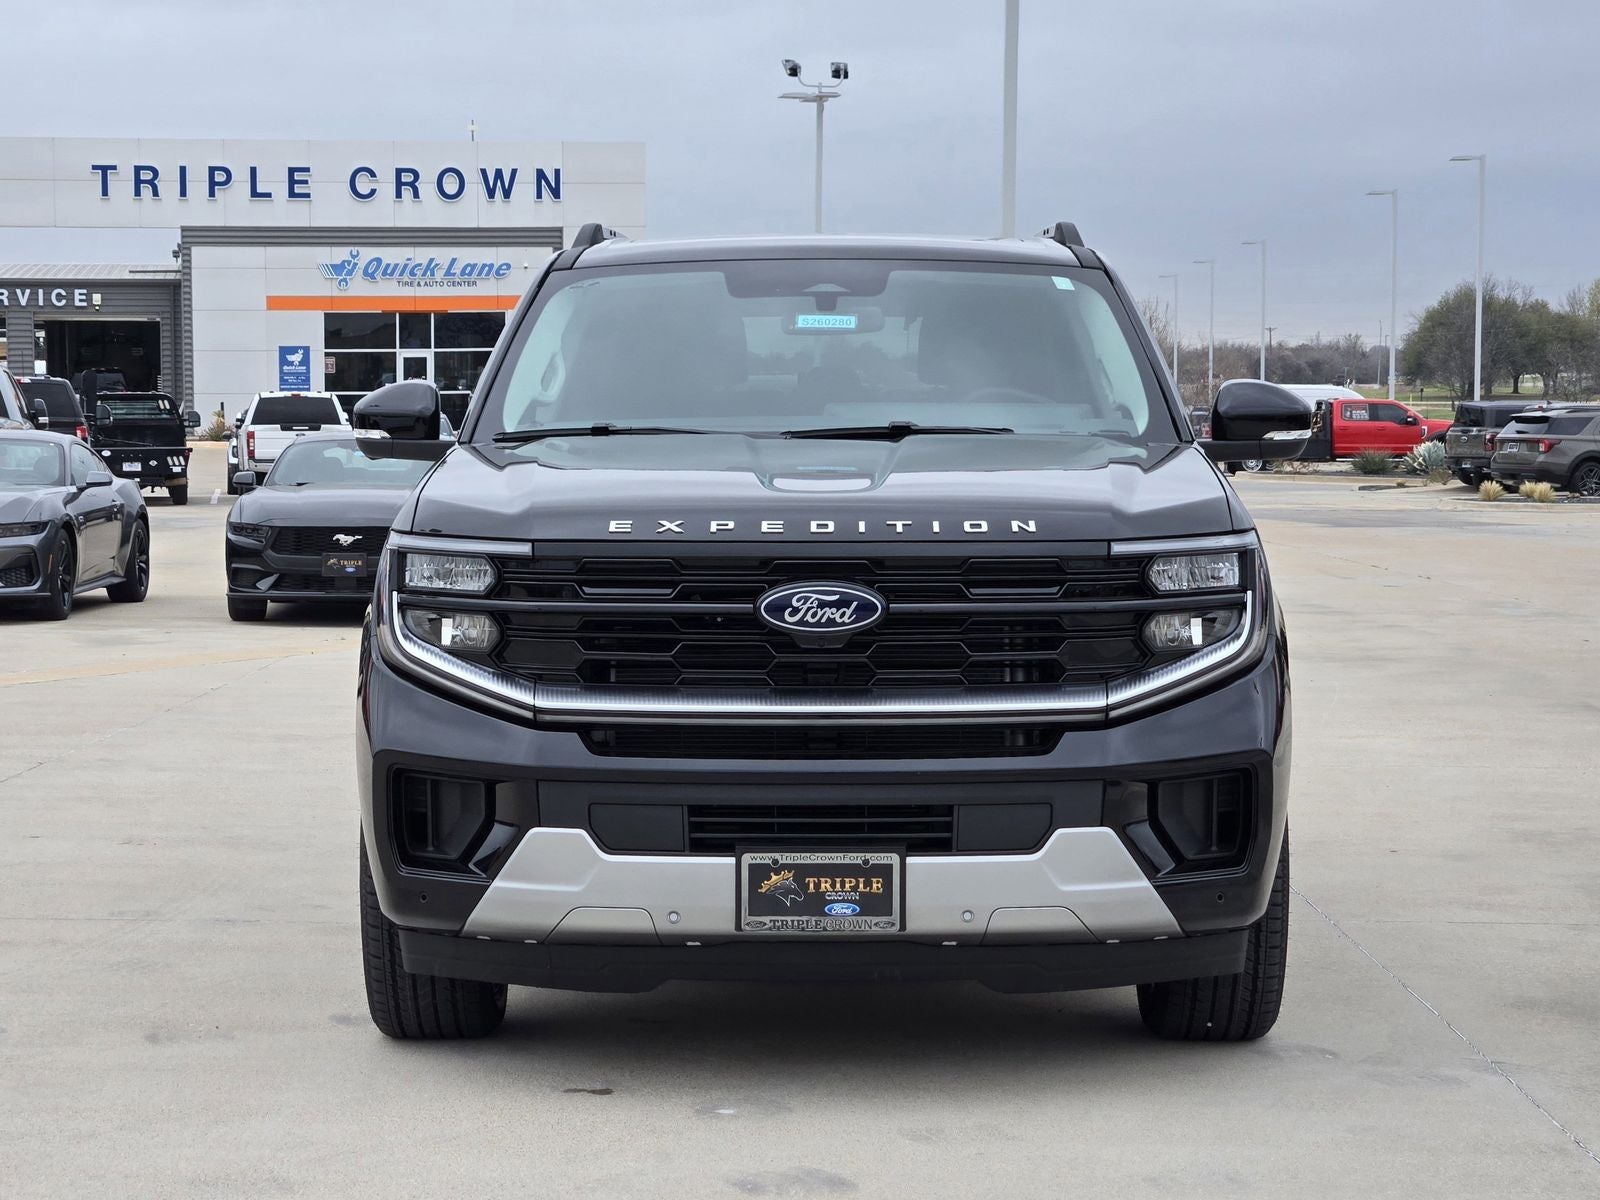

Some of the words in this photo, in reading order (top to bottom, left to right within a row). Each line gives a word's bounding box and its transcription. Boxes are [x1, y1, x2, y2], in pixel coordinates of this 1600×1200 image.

[90, 163, 313, 201] TRIPLE
[349, 166, 563, 203] CROWN
[362, 256, 441, 282] Quick
[443, 256, 512, 279] Lane
[396, 280, 415, 288] TIRE
[416, 280, 423, 288] &
[424, 280, 445, 288] AUTO
[446, 280, 477, 288] CENTER
[801, 317, 852, 327] S260280
[608, 519, 1038, 534] EXPEDITION
[783, 593, 857, 625] Ford
[805, 877, 883, 894] TRIPLE
[825, 892, 859, 900] CROWN
[831, 904, 853, 914] Ford
[769, 919, 823, 930] TRIPLE
[825, 919, 873, 930] CROWN
